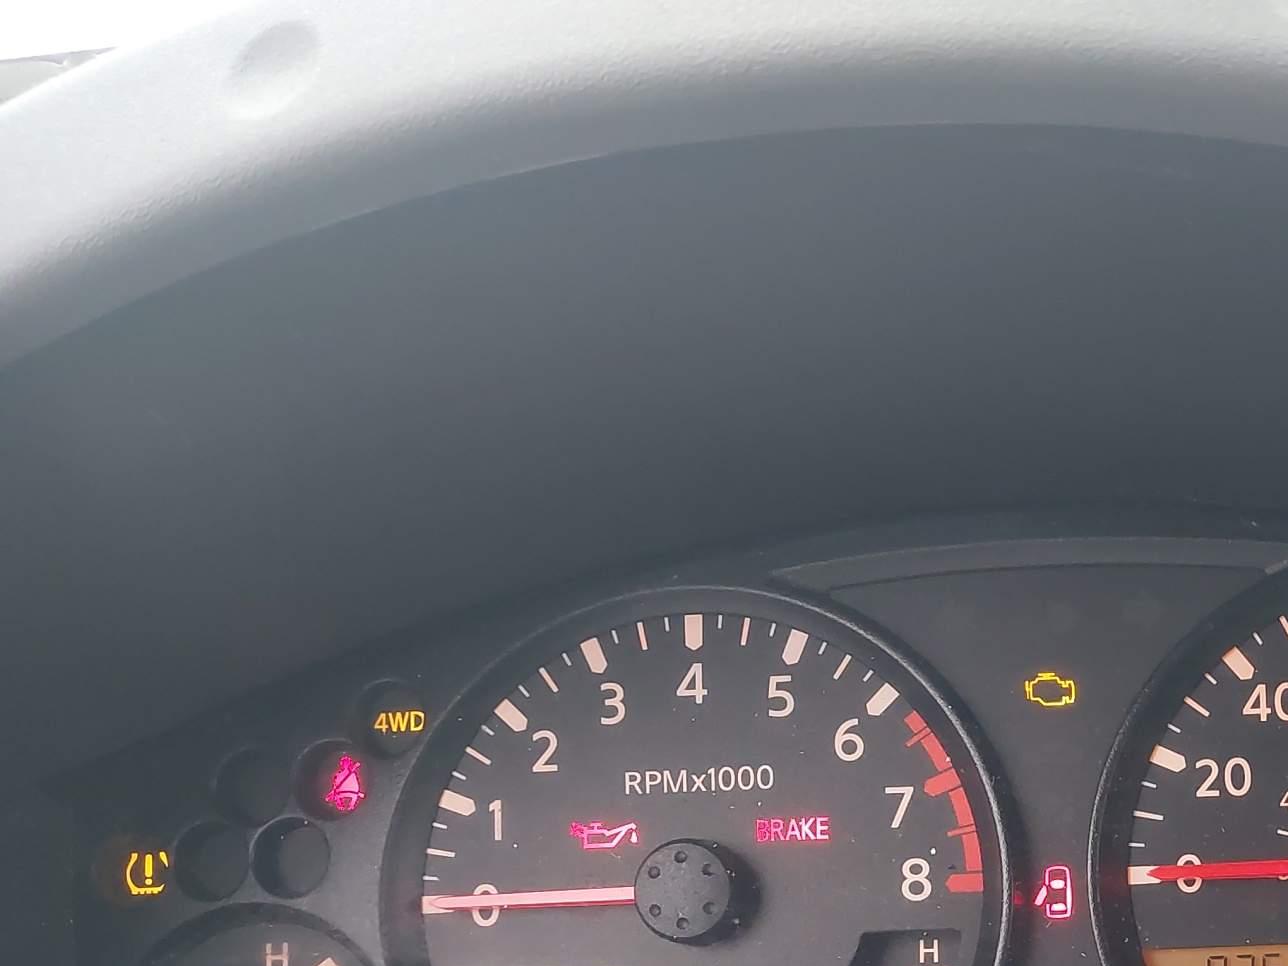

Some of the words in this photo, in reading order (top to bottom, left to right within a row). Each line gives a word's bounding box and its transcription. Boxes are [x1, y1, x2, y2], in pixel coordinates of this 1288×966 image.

[600, 682, 626, 725] 3
[676, 662, 708, 704] 4
[767, 675, 795, 718] 5
[374, 710, 425, 734] 4WD
[834, 718, 865, 762] 6
[532, 730, 558, 773] 2
[624, 764, 775, 796] RPMx1000
[1195, 757, 1252, 798] 20
[488, 799, 502, 841] 1
[885, 786, 914, 829] 7
[756, 816, 829, 843] BRAKE
[901, 857, 932, 902] 8
[1176, 853, 1203, 894] 0
[471, 883, 501, 927] 0
[919, 938, 940, 964] H
